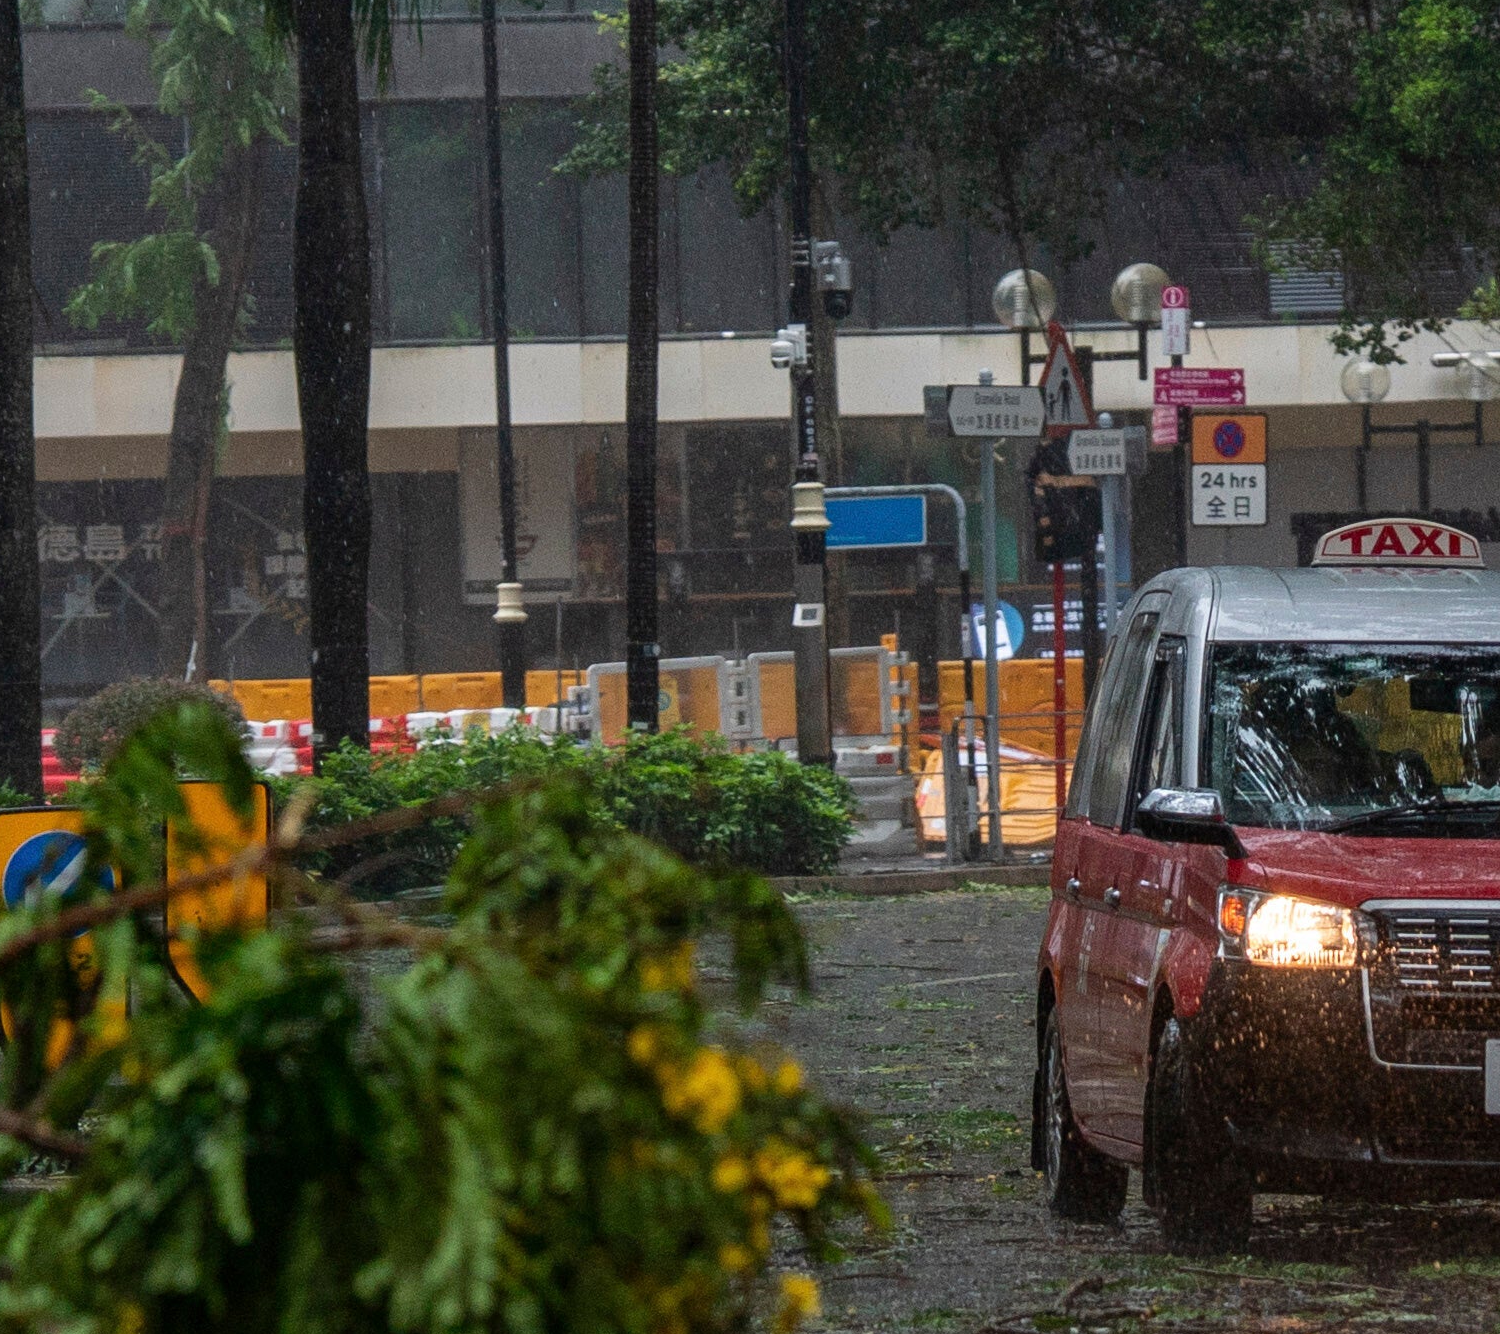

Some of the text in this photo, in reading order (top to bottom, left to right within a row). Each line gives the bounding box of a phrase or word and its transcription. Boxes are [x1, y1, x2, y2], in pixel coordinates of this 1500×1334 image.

[1201, 471, 1257, 489] 24 hrs
[1206, 495, 1251, 518] 全日
[1339, 524, 1462, 557] TAXI
